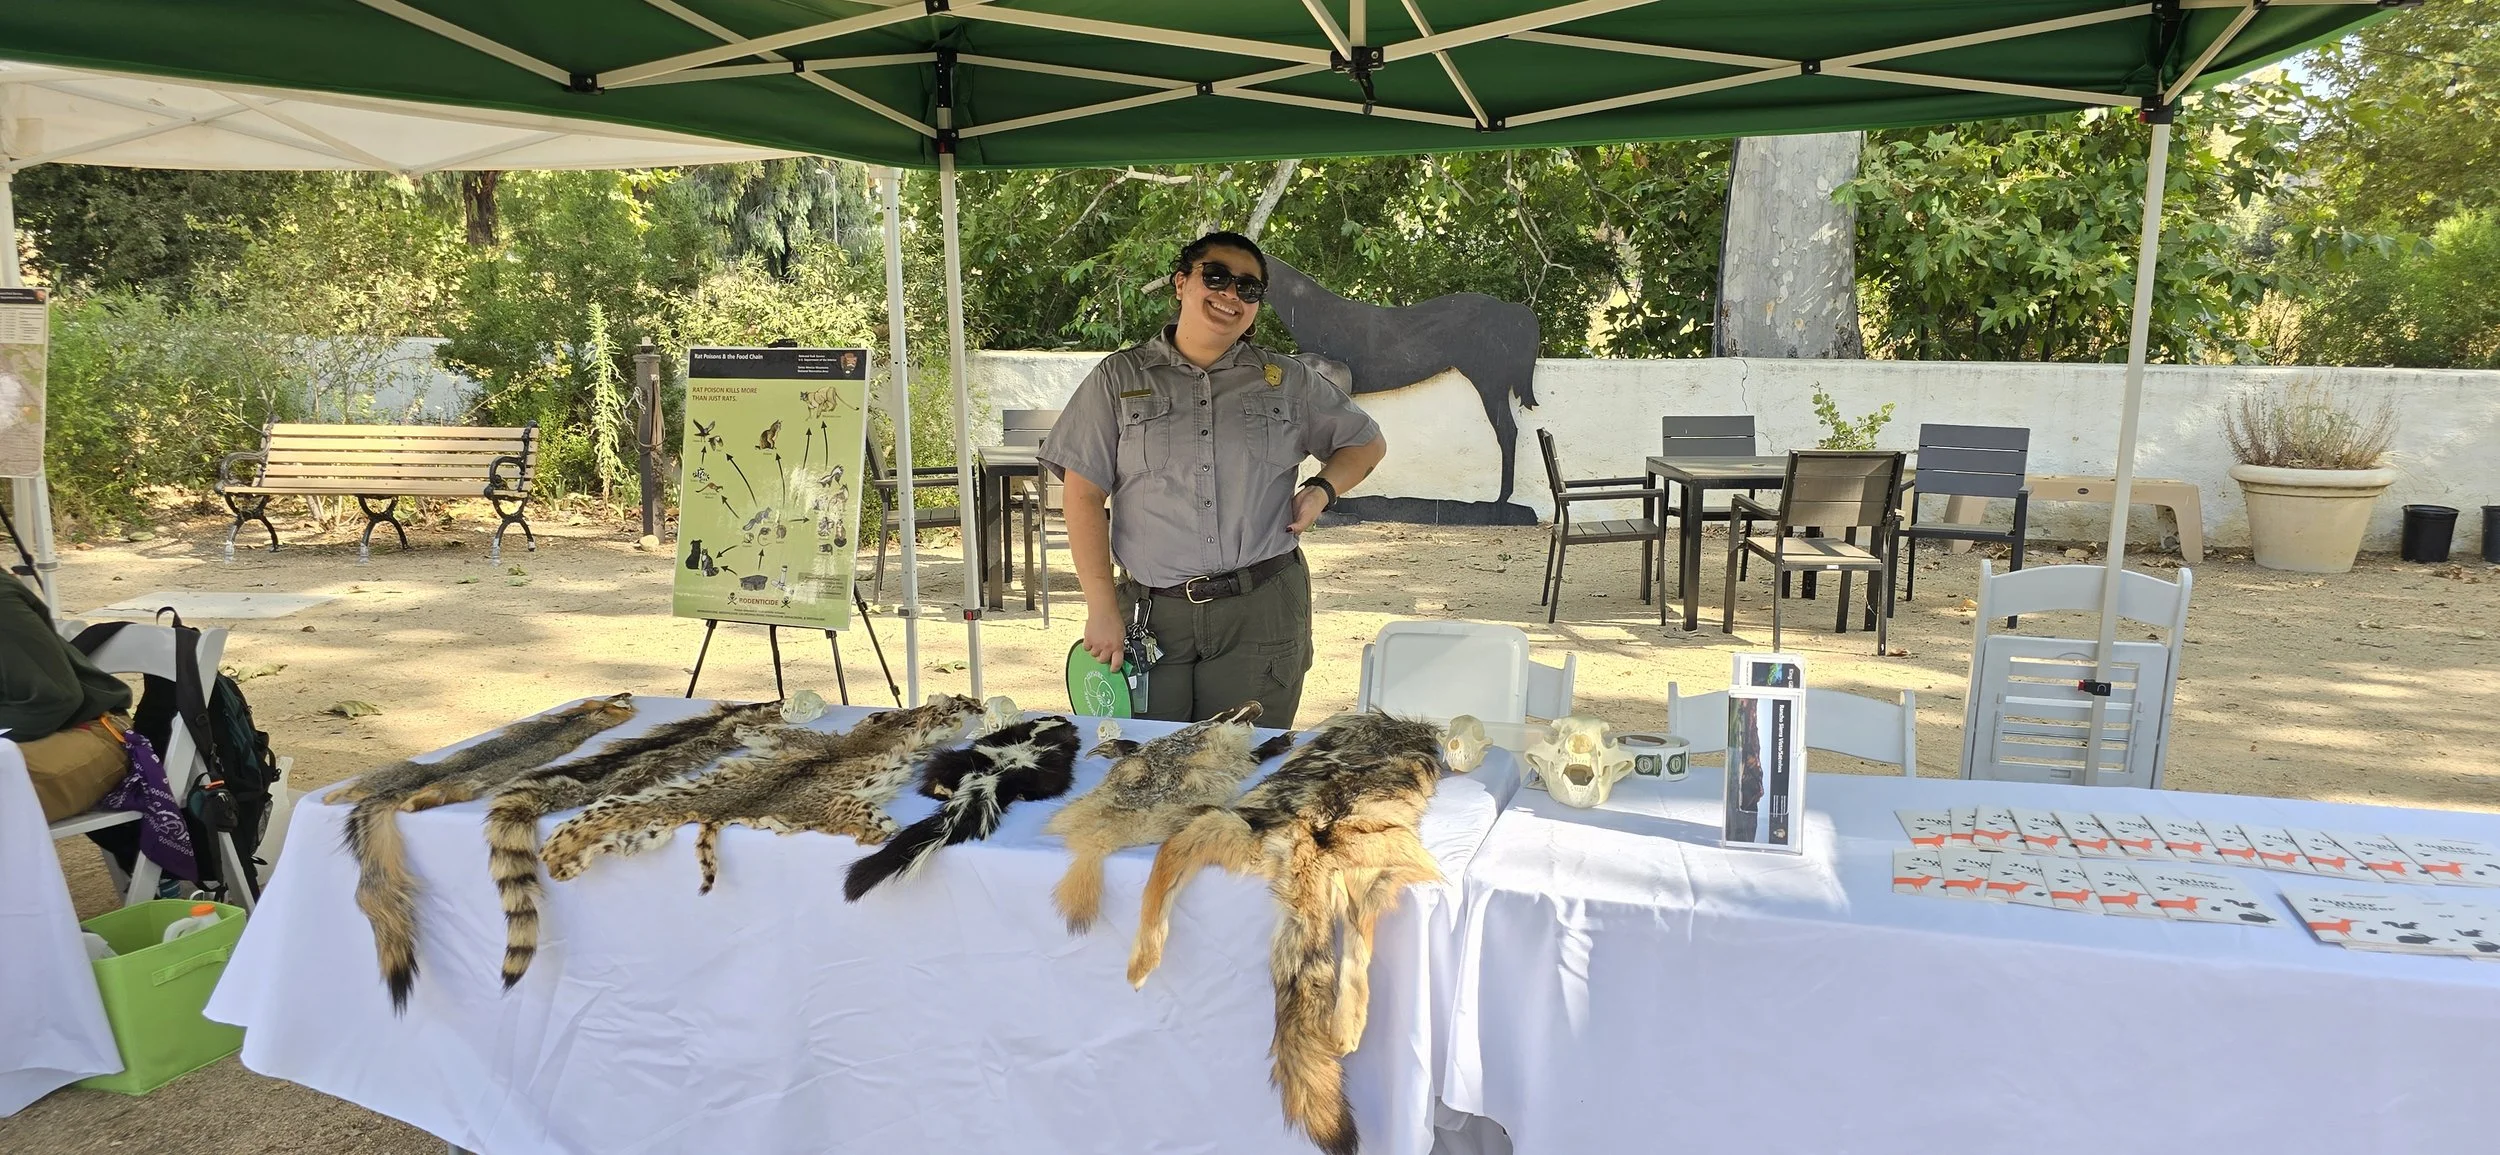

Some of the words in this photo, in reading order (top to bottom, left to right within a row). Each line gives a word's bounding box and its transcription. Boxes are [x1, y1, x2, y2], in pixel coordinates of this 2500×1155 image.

[739, 597, 779, 606] RODENTICIDE
[2156, 875, 2217, 885] Junior
[2309, 897, 2377, 907] Junior
